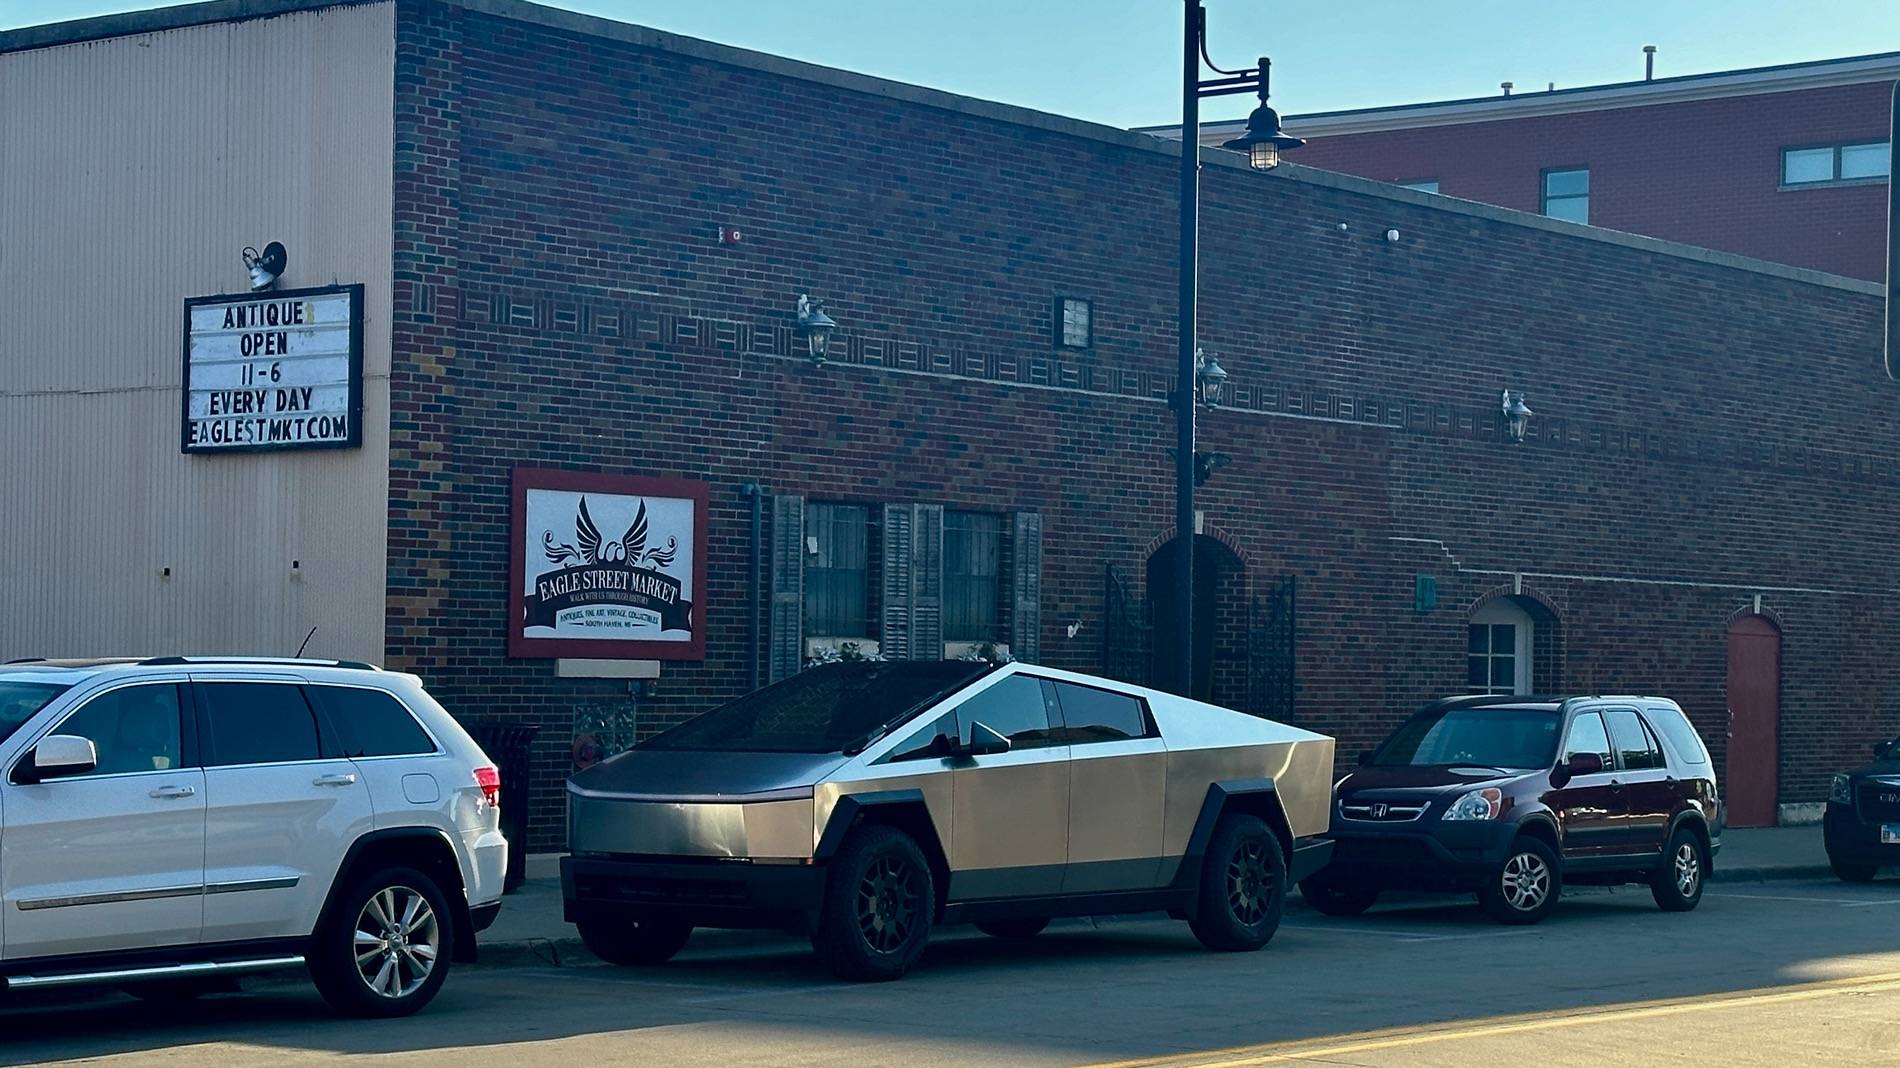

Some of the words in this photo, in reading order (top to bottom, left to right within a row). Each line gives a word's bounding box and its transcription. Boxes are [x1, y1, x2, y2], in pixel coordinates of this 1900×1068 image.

[241, 331, 287, 357] OPEN
[241, 362, 281, 385] 11-6
[210, 390, 267, 415] EVERY
[276, 387, 313, 412] DAY
[539, 572, 581, 602] EAGLE
[582, 569, 630, 590] STREET
[631, 573, 678, 605] MARKET
[585, 620, 602, 628] SOUTH
